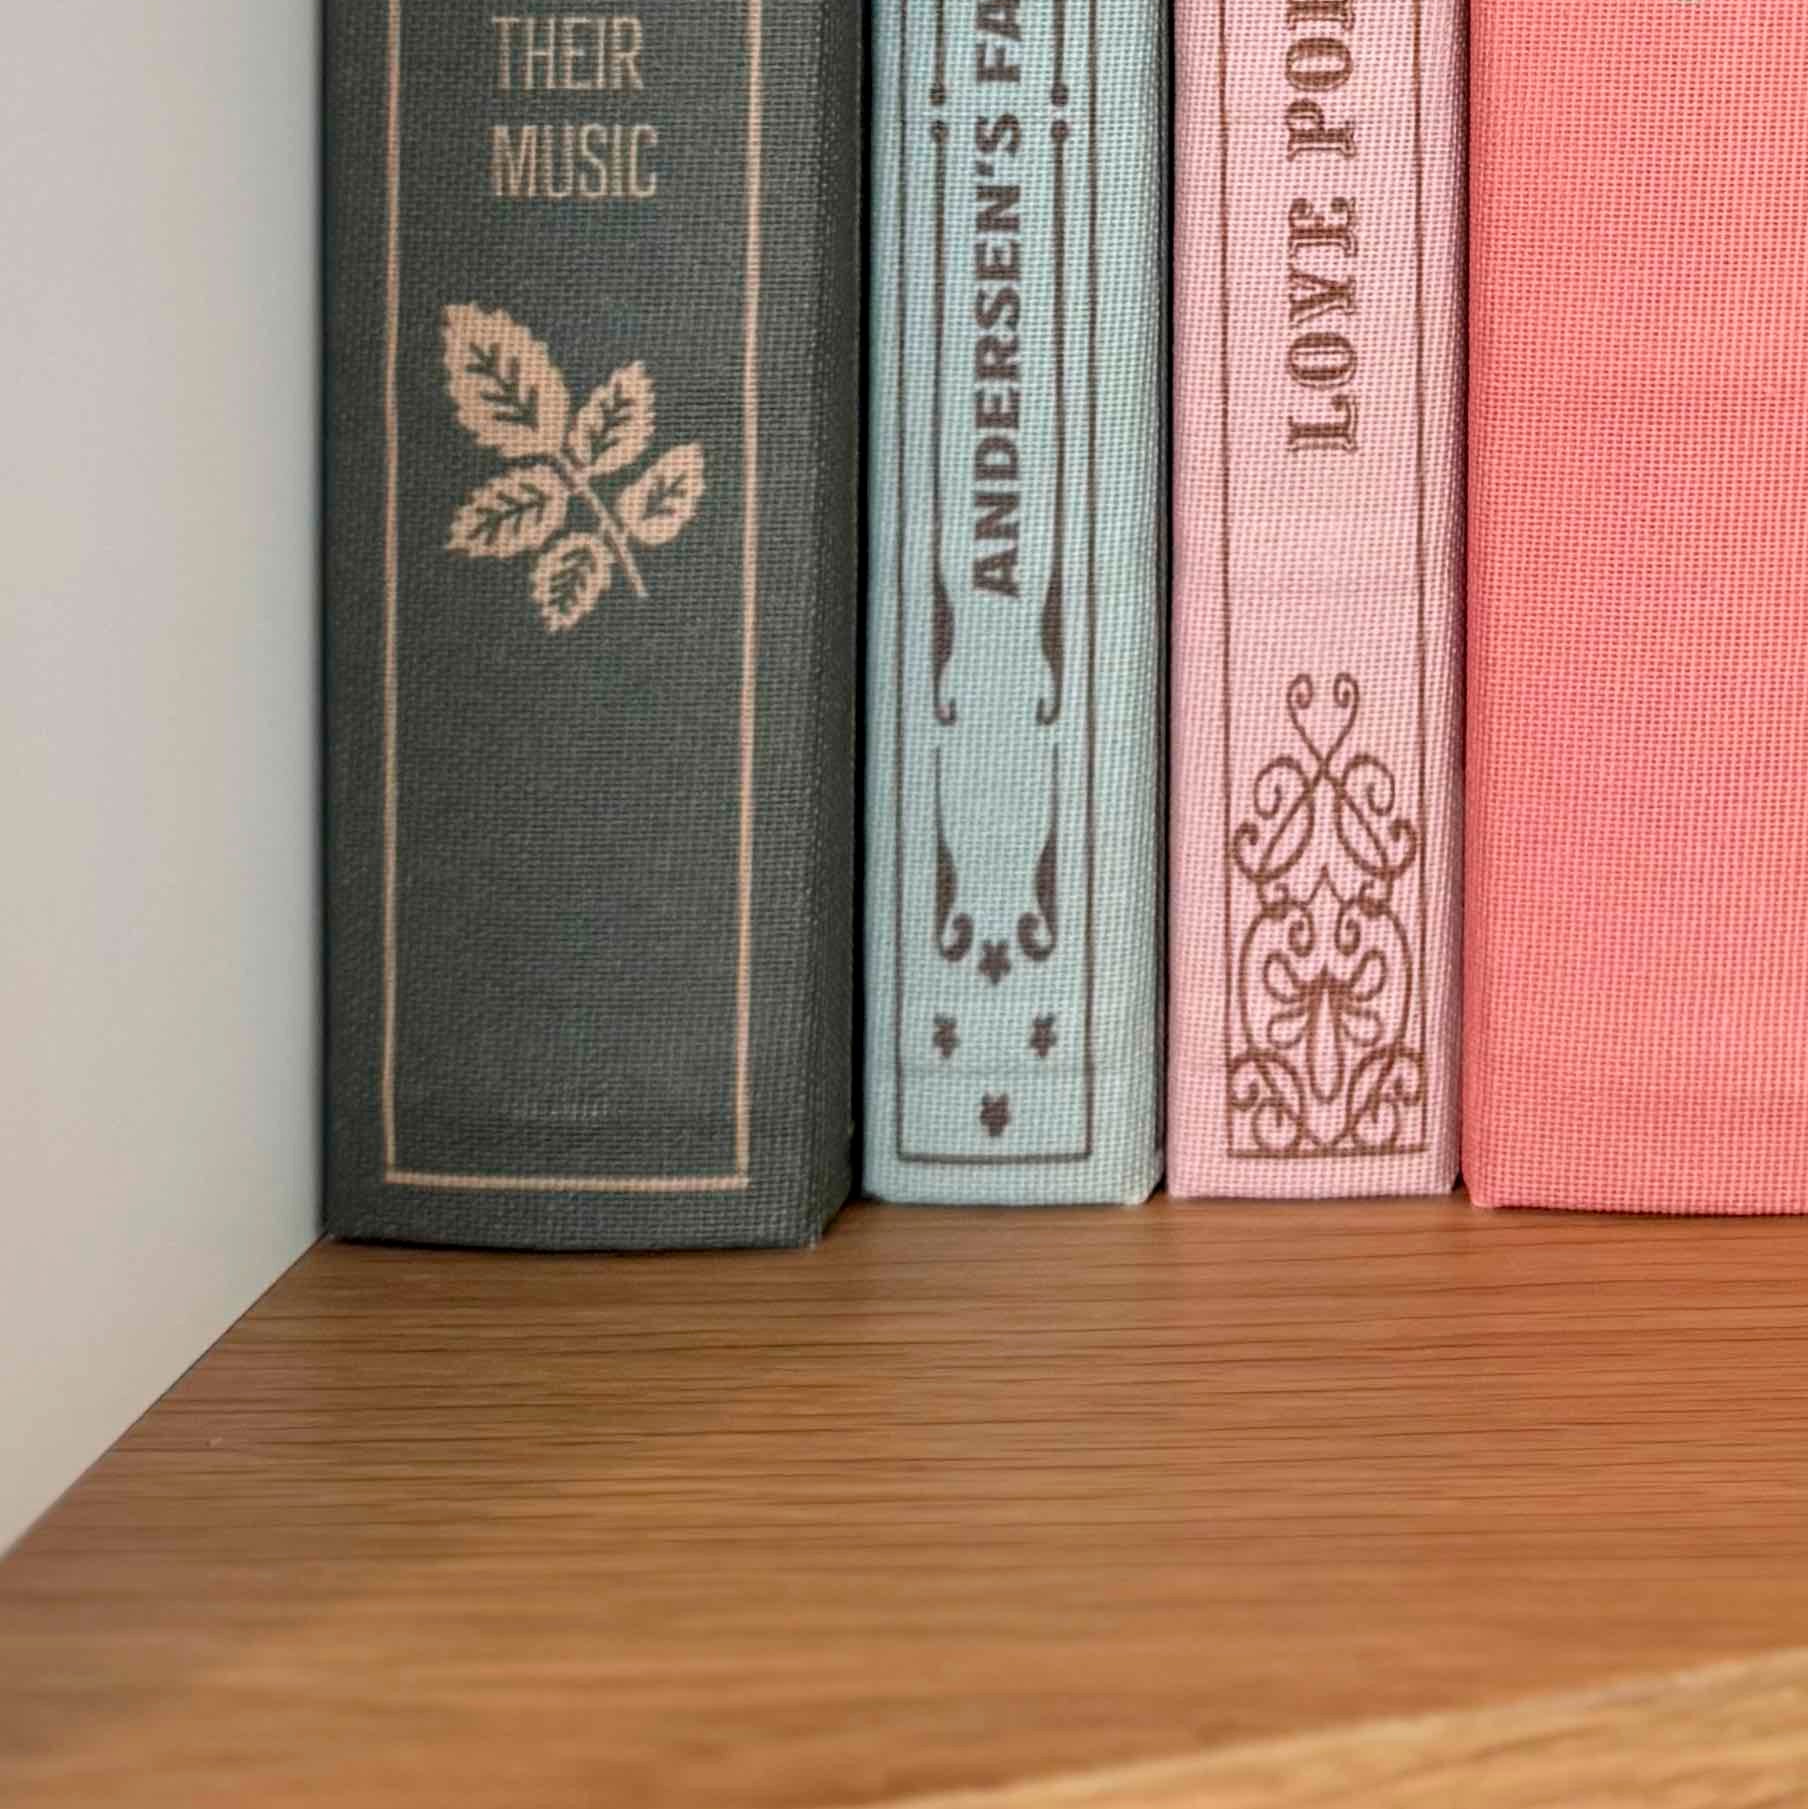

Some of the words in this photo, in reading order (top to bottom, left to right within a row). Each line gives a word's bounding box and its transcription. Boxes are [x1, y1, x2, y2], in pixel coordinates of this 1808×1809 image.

[492, 17, 644, 91] THEIR
[490, 124, 658, 198] MUSIC
[971, 113, 1024, 600] ANDERSEN'S
[1286, 196, 1362, 456] LOVE
